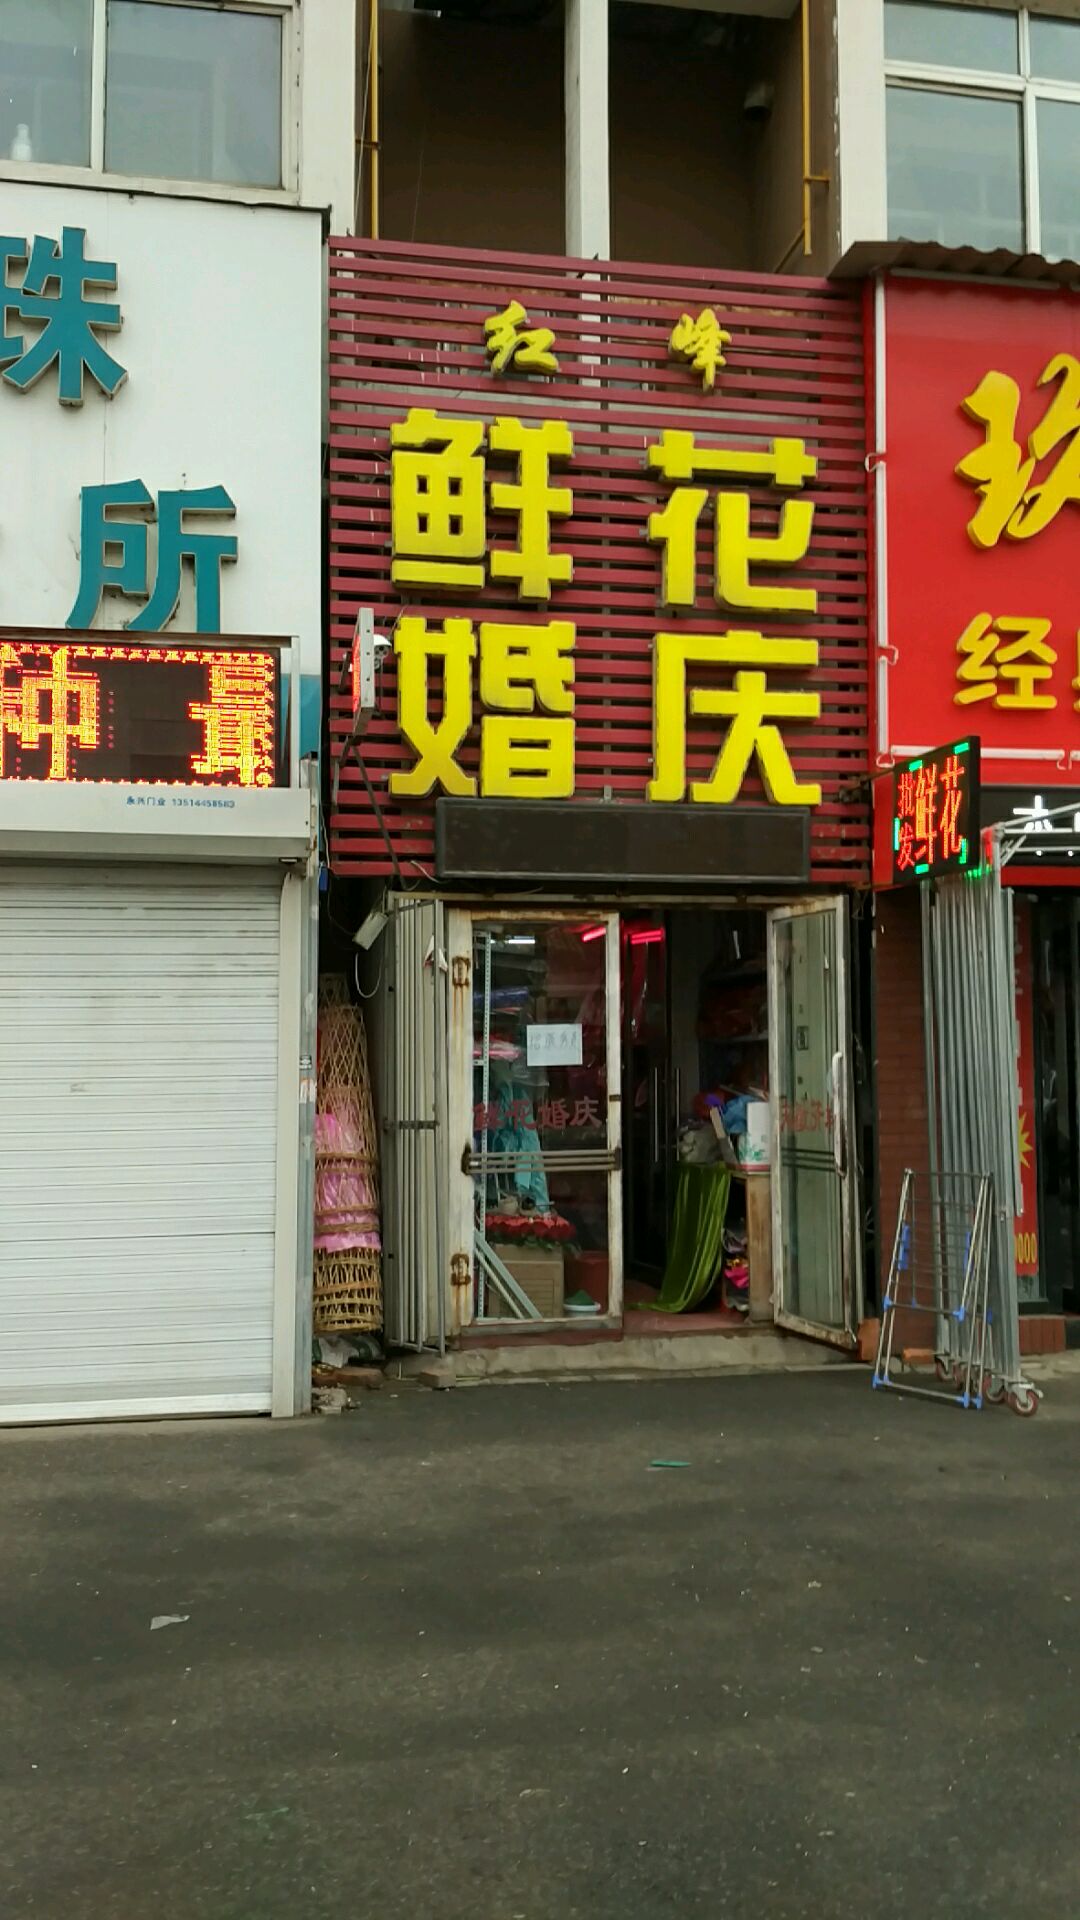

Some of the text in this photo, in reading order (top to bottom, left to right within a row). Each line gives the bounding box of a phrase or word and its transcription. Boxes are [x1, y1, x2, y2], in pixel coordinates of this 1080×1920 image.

[66, 479, 239, 634] 所
[390, 408, 819, 614] 鲜花
[389, 617, 823, 806] 婚庆
[953, 612, 1080, 710] 经
[914, 755, 966, 866] 鲜花
